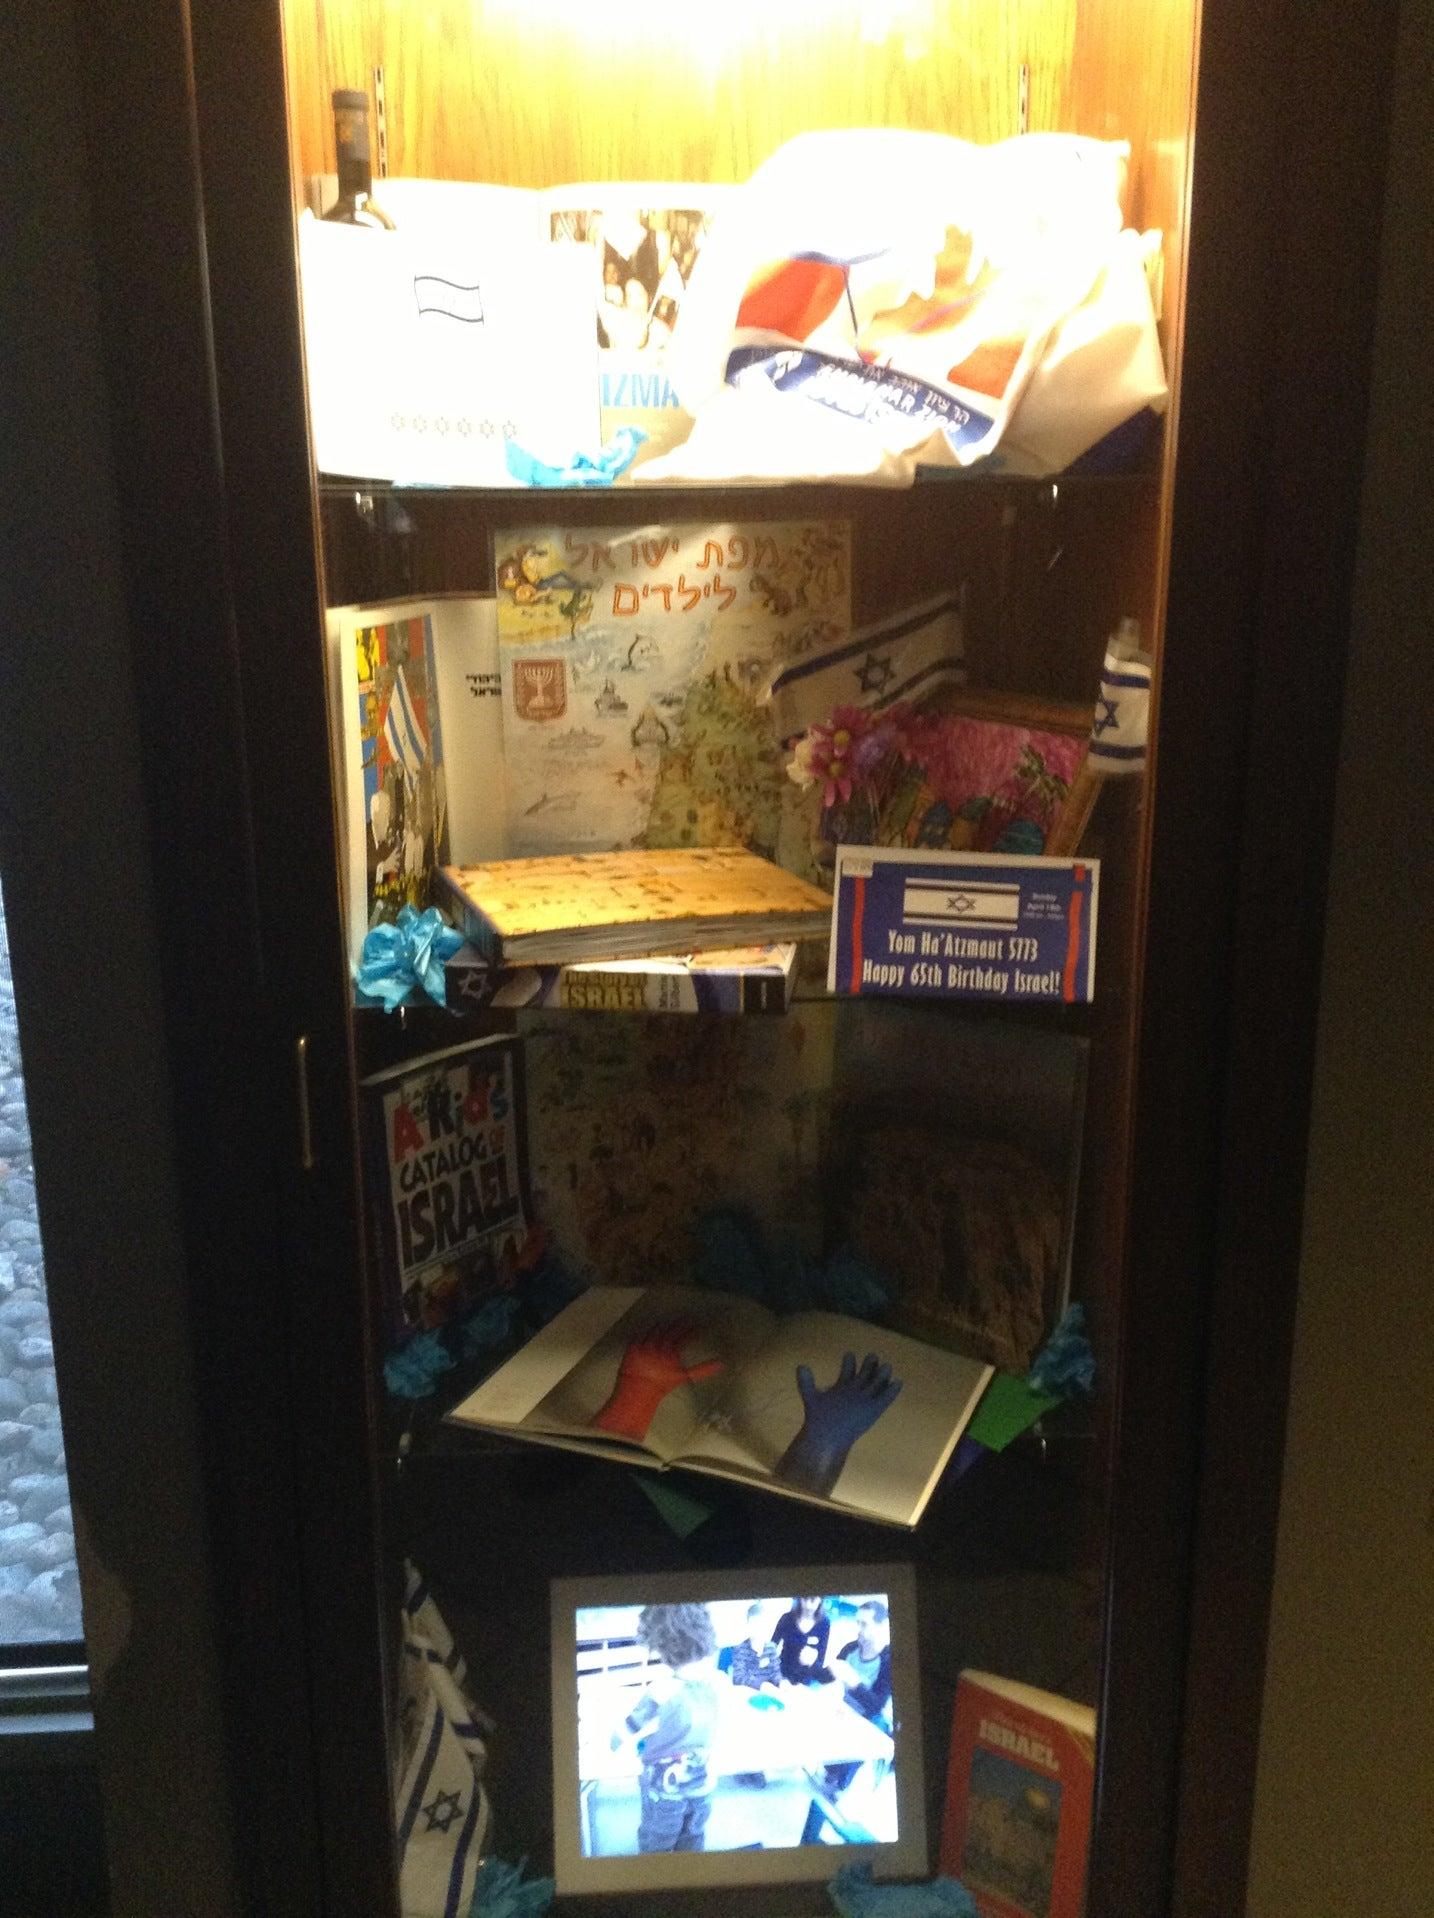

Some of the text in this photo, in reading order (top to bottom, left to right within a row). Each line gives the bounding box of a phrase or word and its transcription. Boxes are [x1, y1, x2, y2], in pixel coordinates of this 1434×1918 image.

[697, 535, 780, 572] מפת
[612, 573, 738, 617] לילדים
[888, 929, 916, 954] Yom
[1008, 937, 1039, 962] 5773
[561, 984, 648, 1010] ISRAEL
[862, 958, 1061, 996] Happy 65th Birthday Israel!
[400, 1131, 487, 1193] CATALOG
[398, 1154, 520, 1268] ISRAEL
[979, 1719, 1060, 1772] ISRAEL
